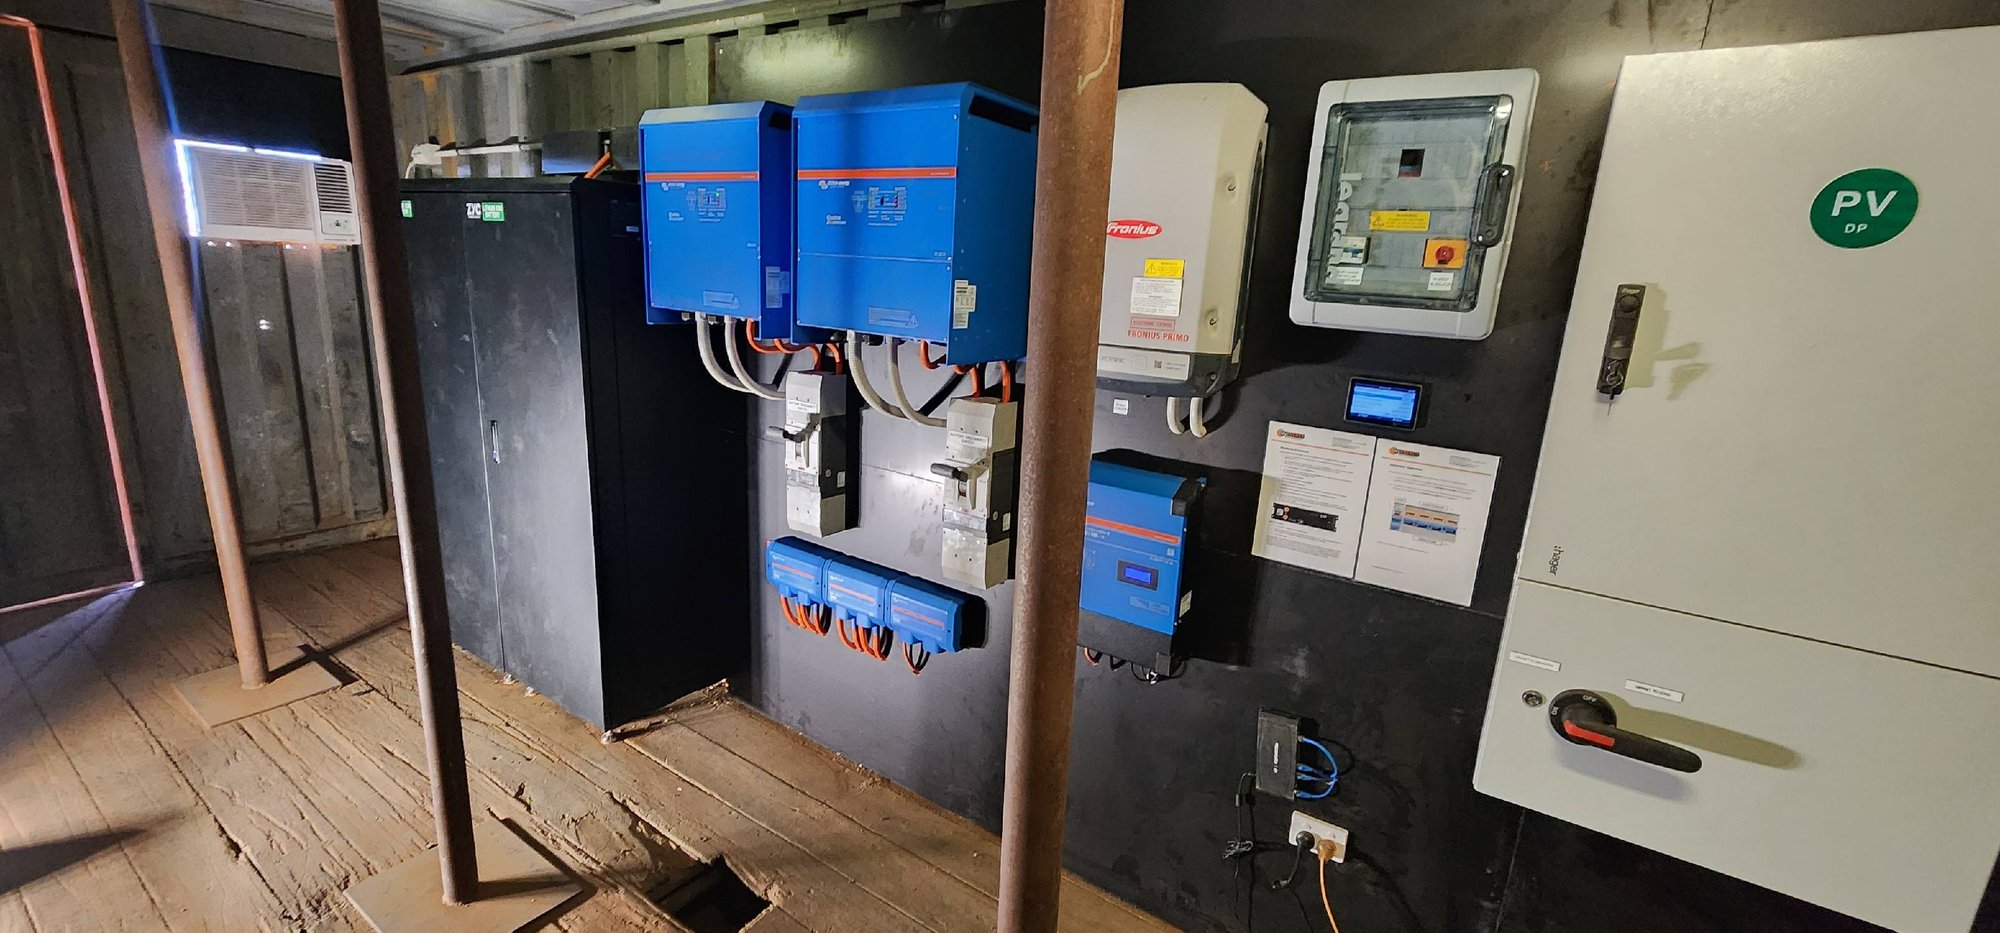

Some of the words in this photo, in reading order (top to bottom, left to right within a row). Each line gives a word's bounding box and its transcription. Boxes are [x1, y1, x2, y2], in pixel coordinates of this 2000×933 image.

[1831, 190, 1898, 217] PV
[1107, 223, 1157, 235] Fronius
[1844, 223, 1868, 233] DP
[1127, 330, 1160, 340] FRONIUS
[1163, 333, 1189, 342] PRIMO
